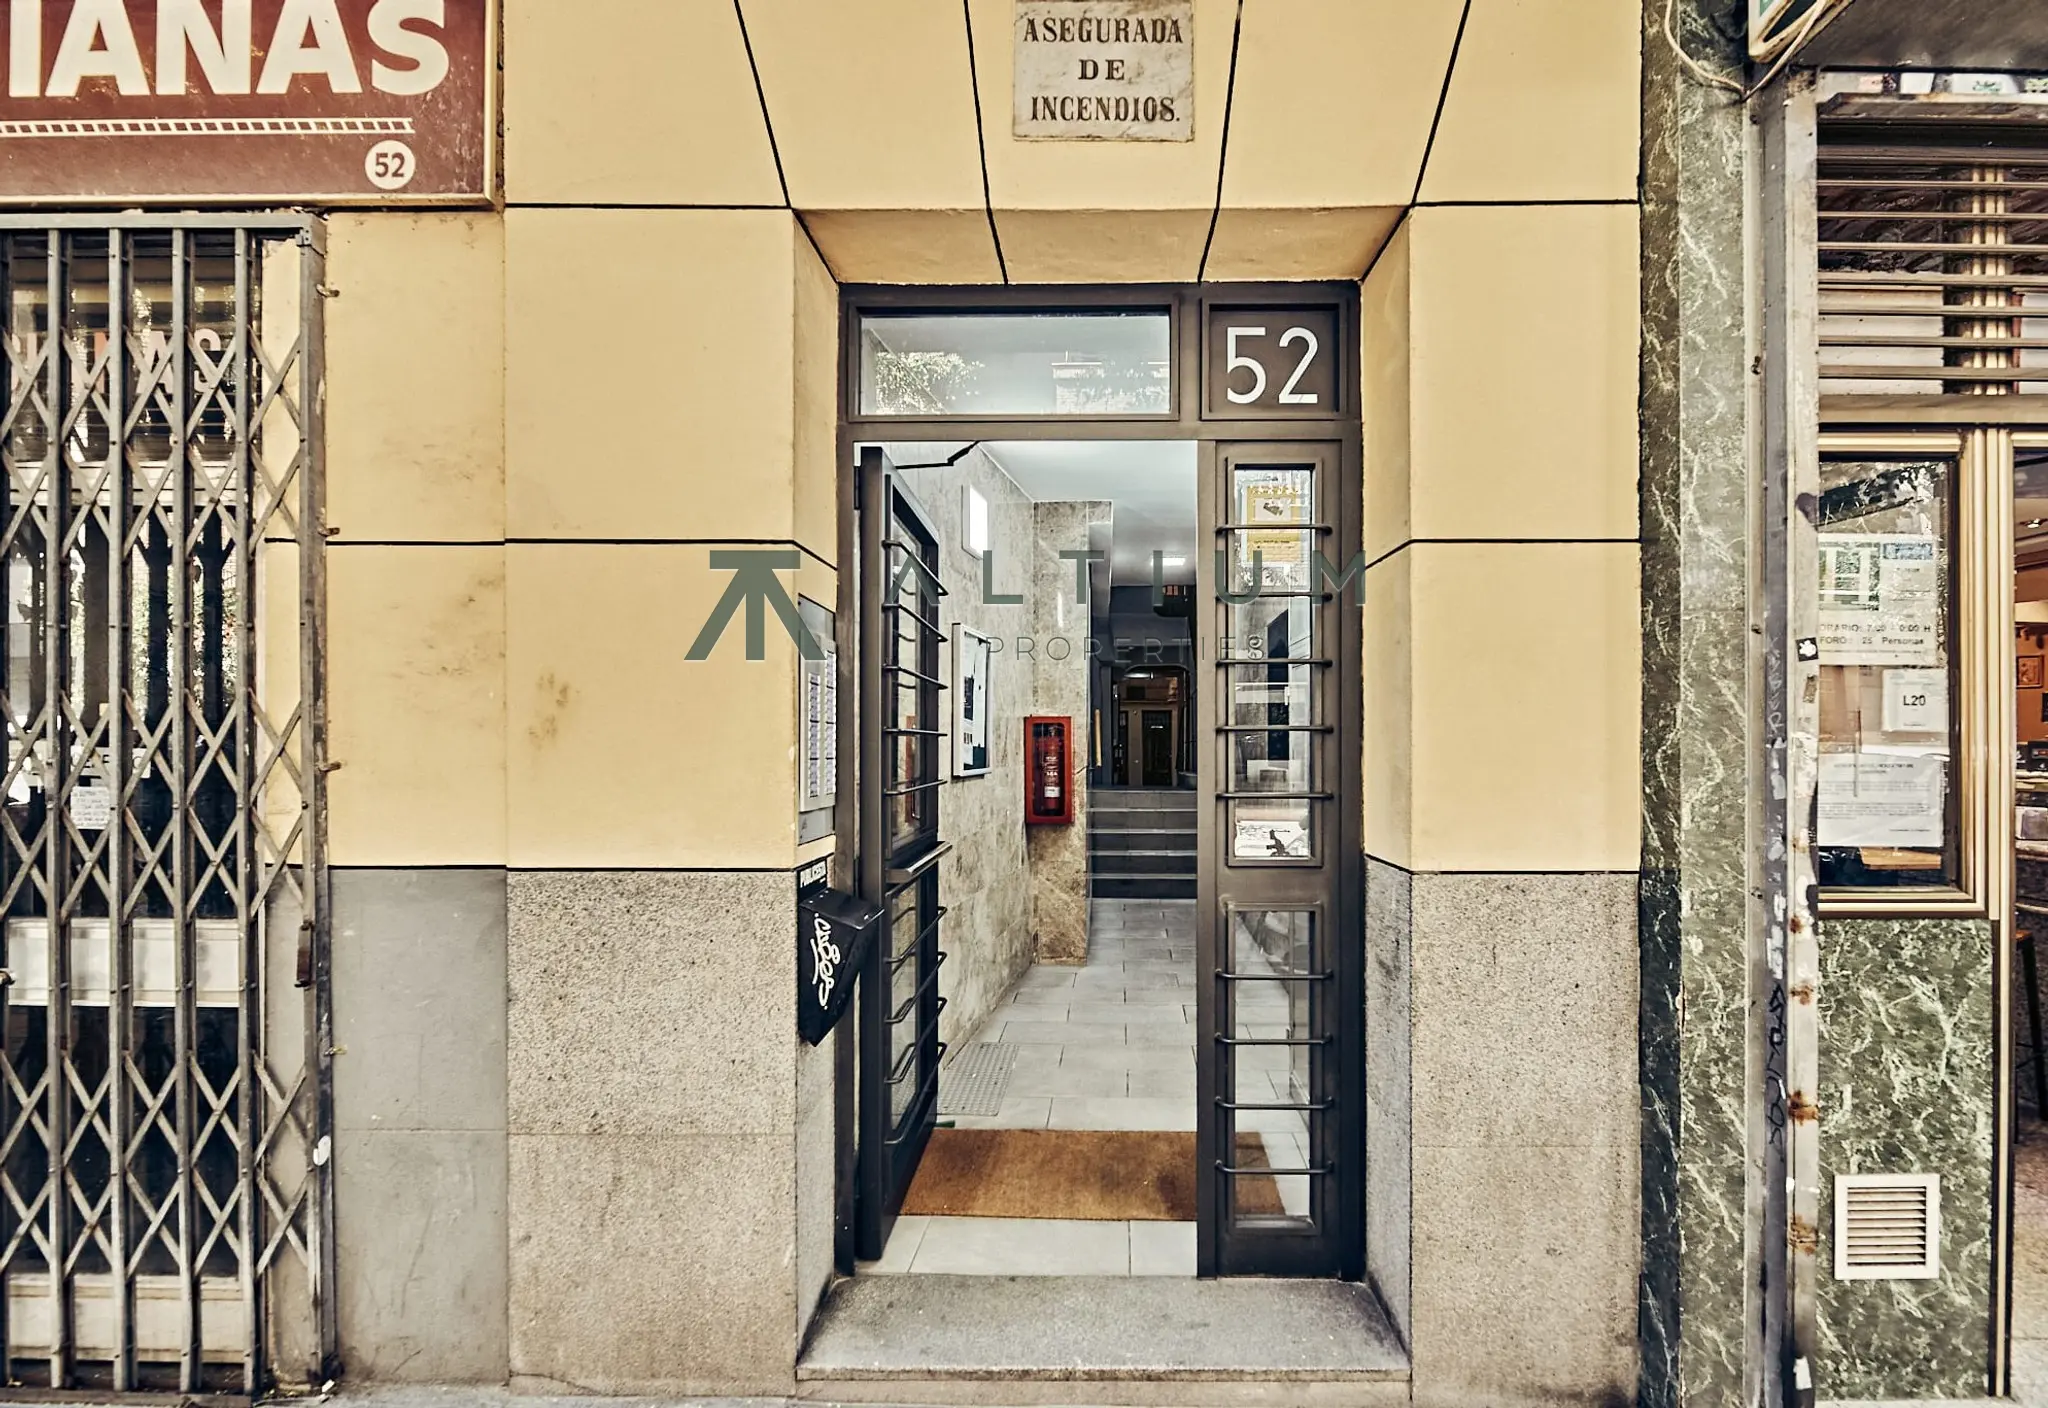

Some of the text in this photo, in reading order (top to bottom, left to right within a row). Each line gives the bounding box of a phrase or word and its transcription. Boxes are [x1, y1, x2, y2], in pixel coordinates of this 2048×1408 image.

[1023, 17, 1184, 43] ASEGURADA
[1078, 59, 1126, 81] DE
[1030, 96, 1181, 122] INCENDIOS.
[375, 152, 405, 178] 52
[1227, 326, 1319, 404] 52
[1903, 695, 1926, 706] L20
